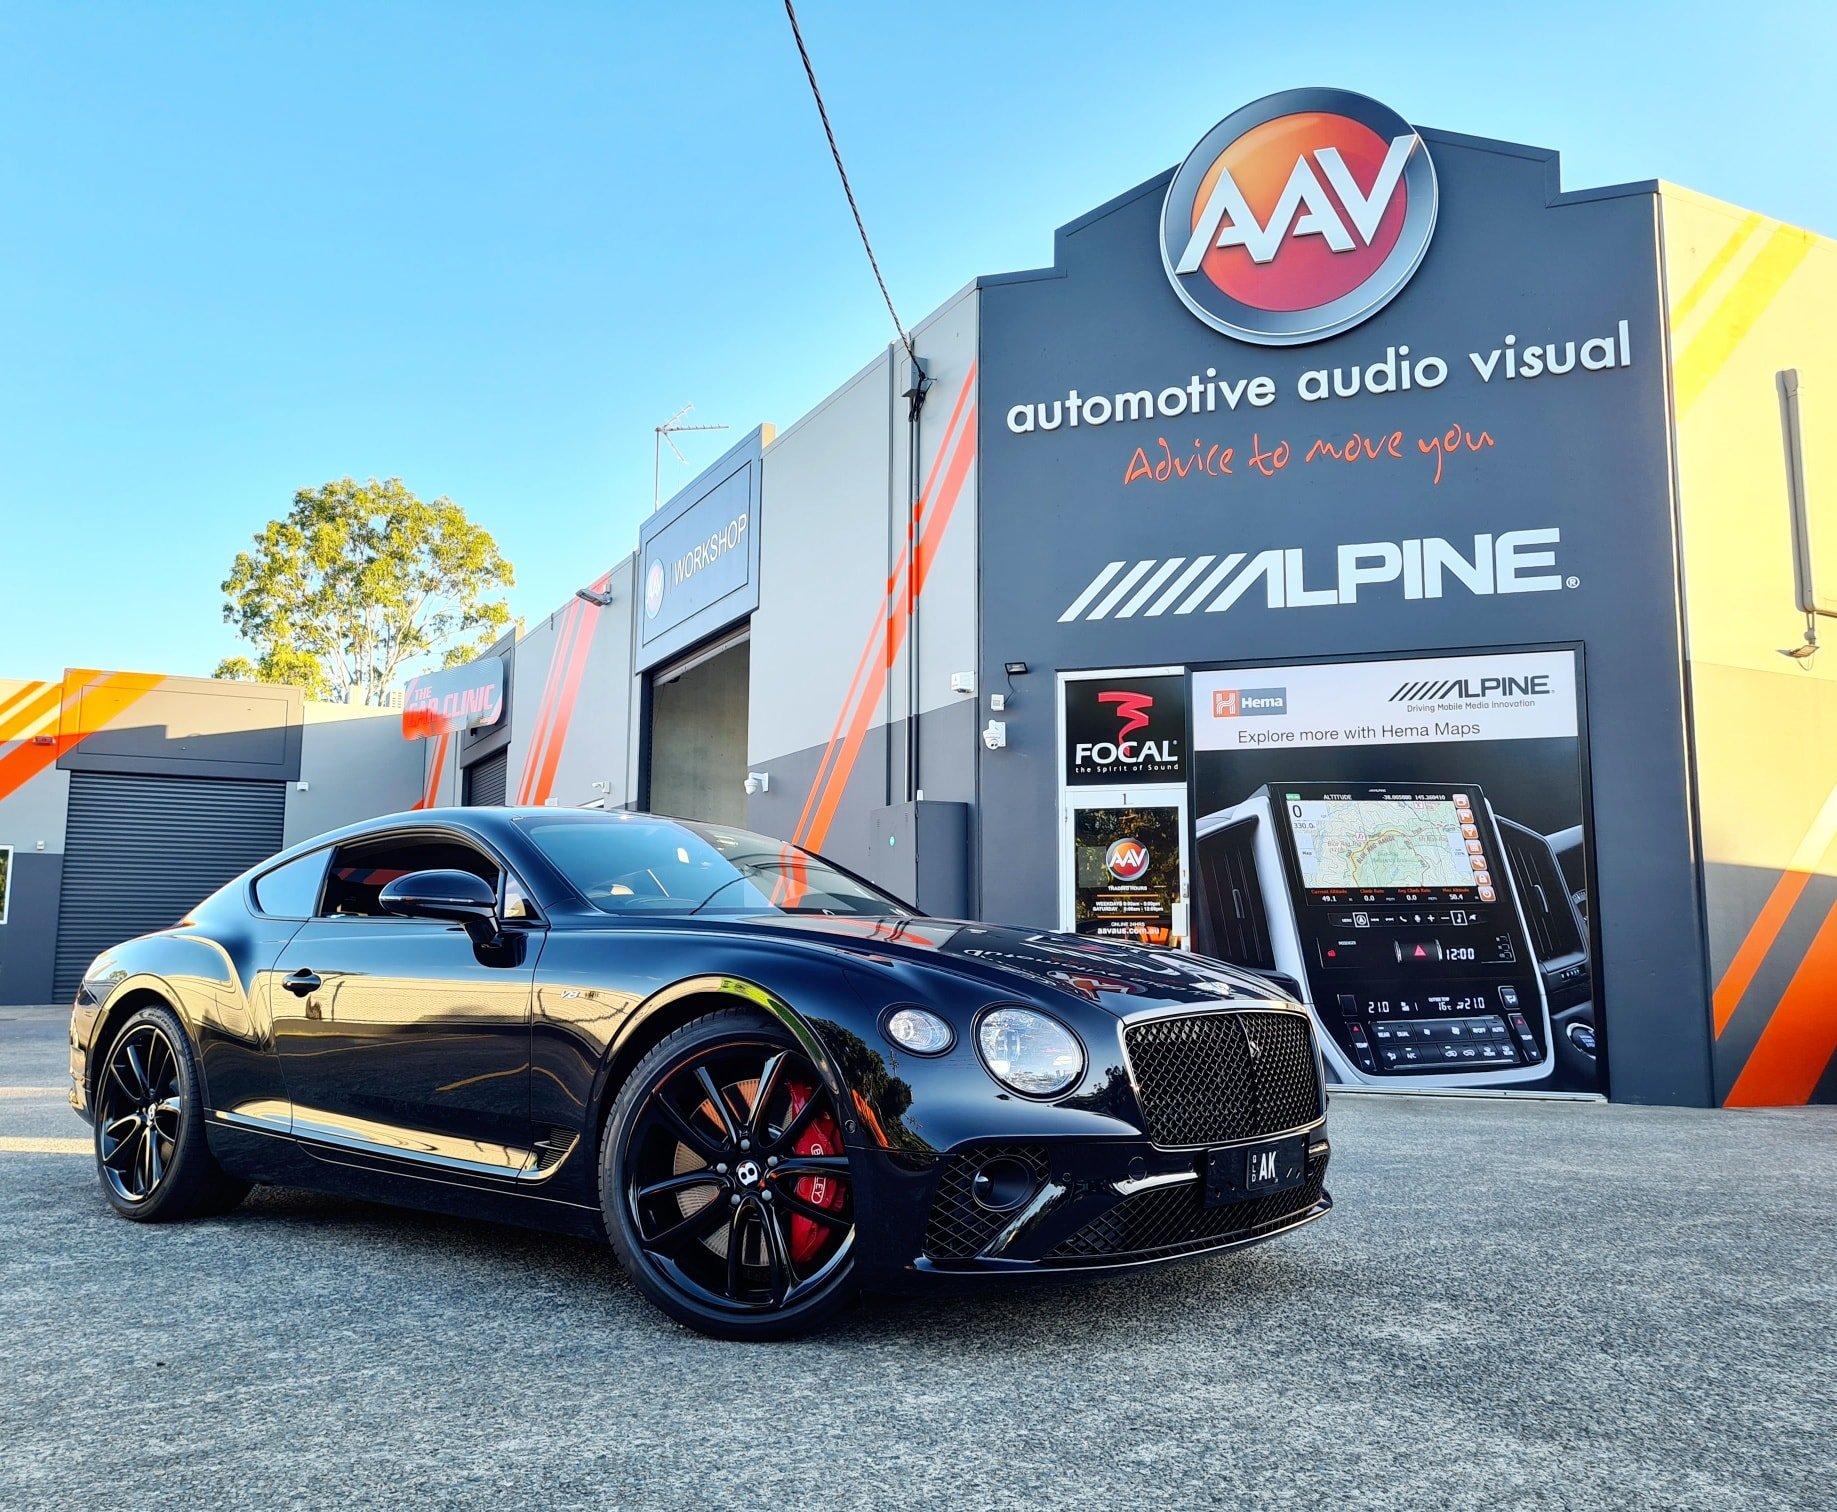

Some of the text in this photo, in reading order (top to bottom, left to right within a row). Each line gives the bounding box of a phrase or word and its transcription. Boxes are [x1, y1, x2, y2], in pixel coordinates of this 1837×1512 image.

[1175, 133, 1420, 275] AAV
[1006, 319, 1632, 433] automotive audio visual
[1123, 423, 1496, 486] Advice to move you
[674, 512, 748, 586] WORKSHOP
[1205, 526, 1564, 613] ALPINE
[414, 685, 433, 702] THE
[1440, 674, 1552, 700] ALPINE
[443, 683, 496, 719] CLINIC
[1241, 694, 1284, 709] Hema
[1406, 698, 1536, 714] Driving Mobile Media Innovation
[1238, 722, 1482, 748] Explore more with Hema Maps
[1075, 740, 1179, 765] FOCAL
[1075, 762, 1180, 774] the Spirit of Sound
[1292, 804, 1303, 818] 0
[1109, 847, 1149, 868] AAV
[1446, 948, 1475, 960] 12:00
[560, 989, 581, 999] V8
[1258, 1150, 1277, 1181] AK
